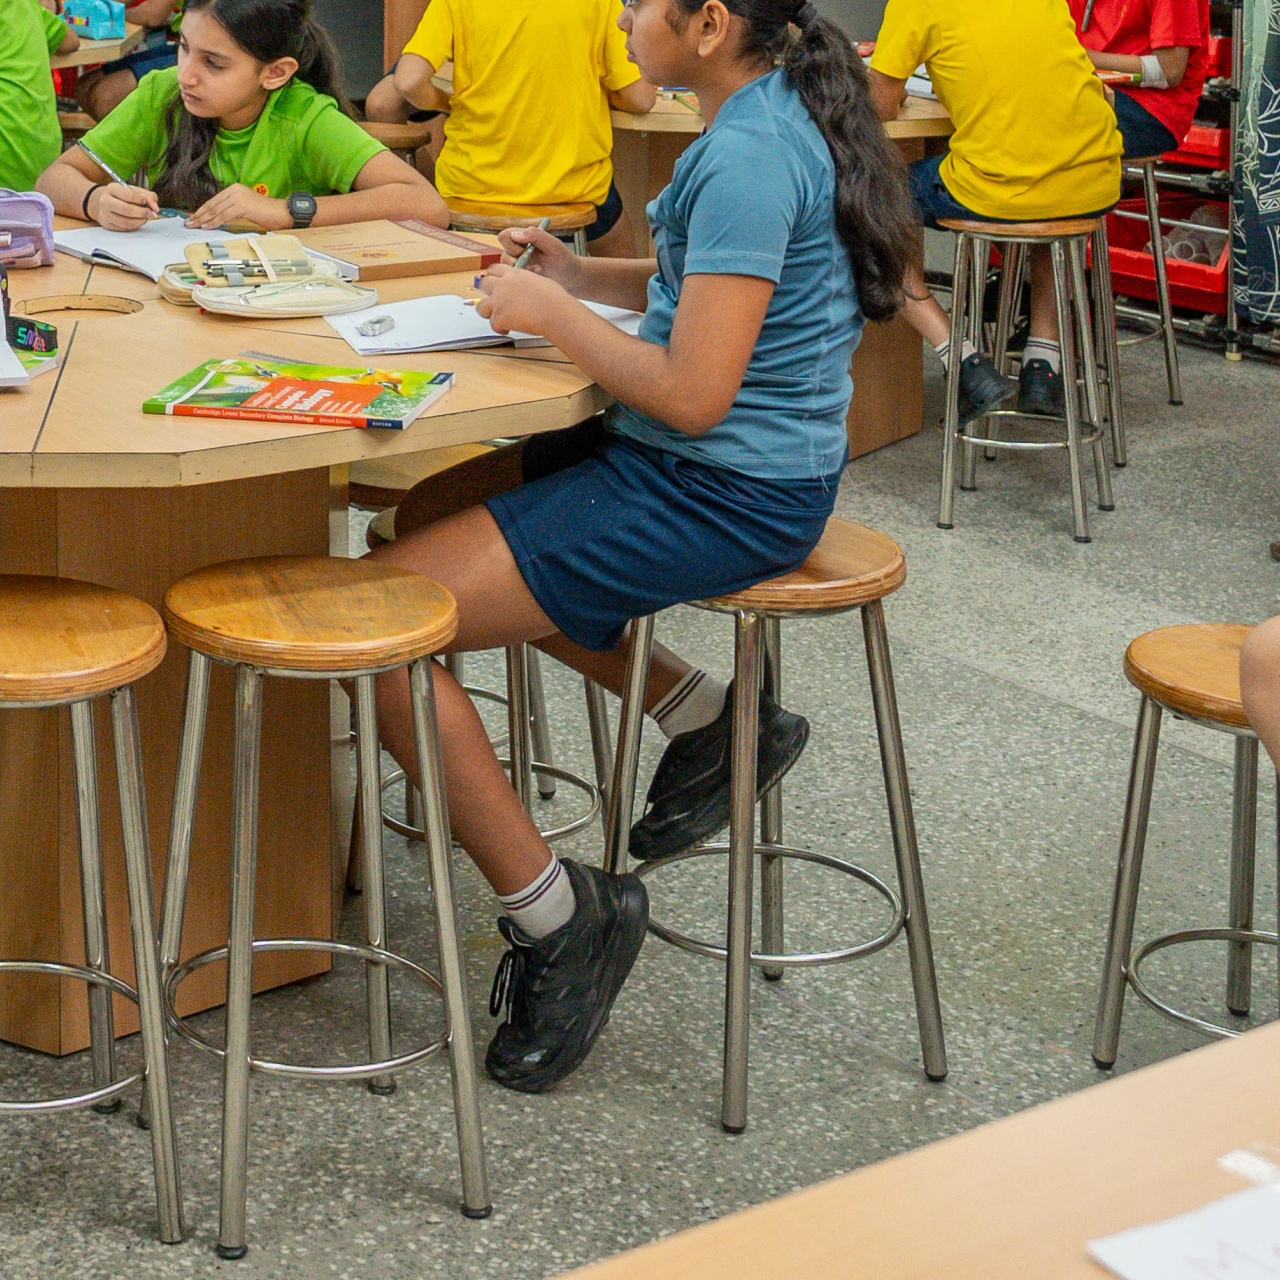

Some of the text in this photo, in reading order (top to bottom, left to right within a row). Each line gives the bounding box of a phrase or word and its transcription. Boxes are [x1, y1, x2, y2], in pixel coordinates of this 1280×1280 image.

[193, 407, 221, 417] Cambridge
[222, 409, 239, 418] Lower
[239, 410, 266, 421] Secondary
[266, 413, 293, 422] Complete
[293, 415, 315, 424] Biology
